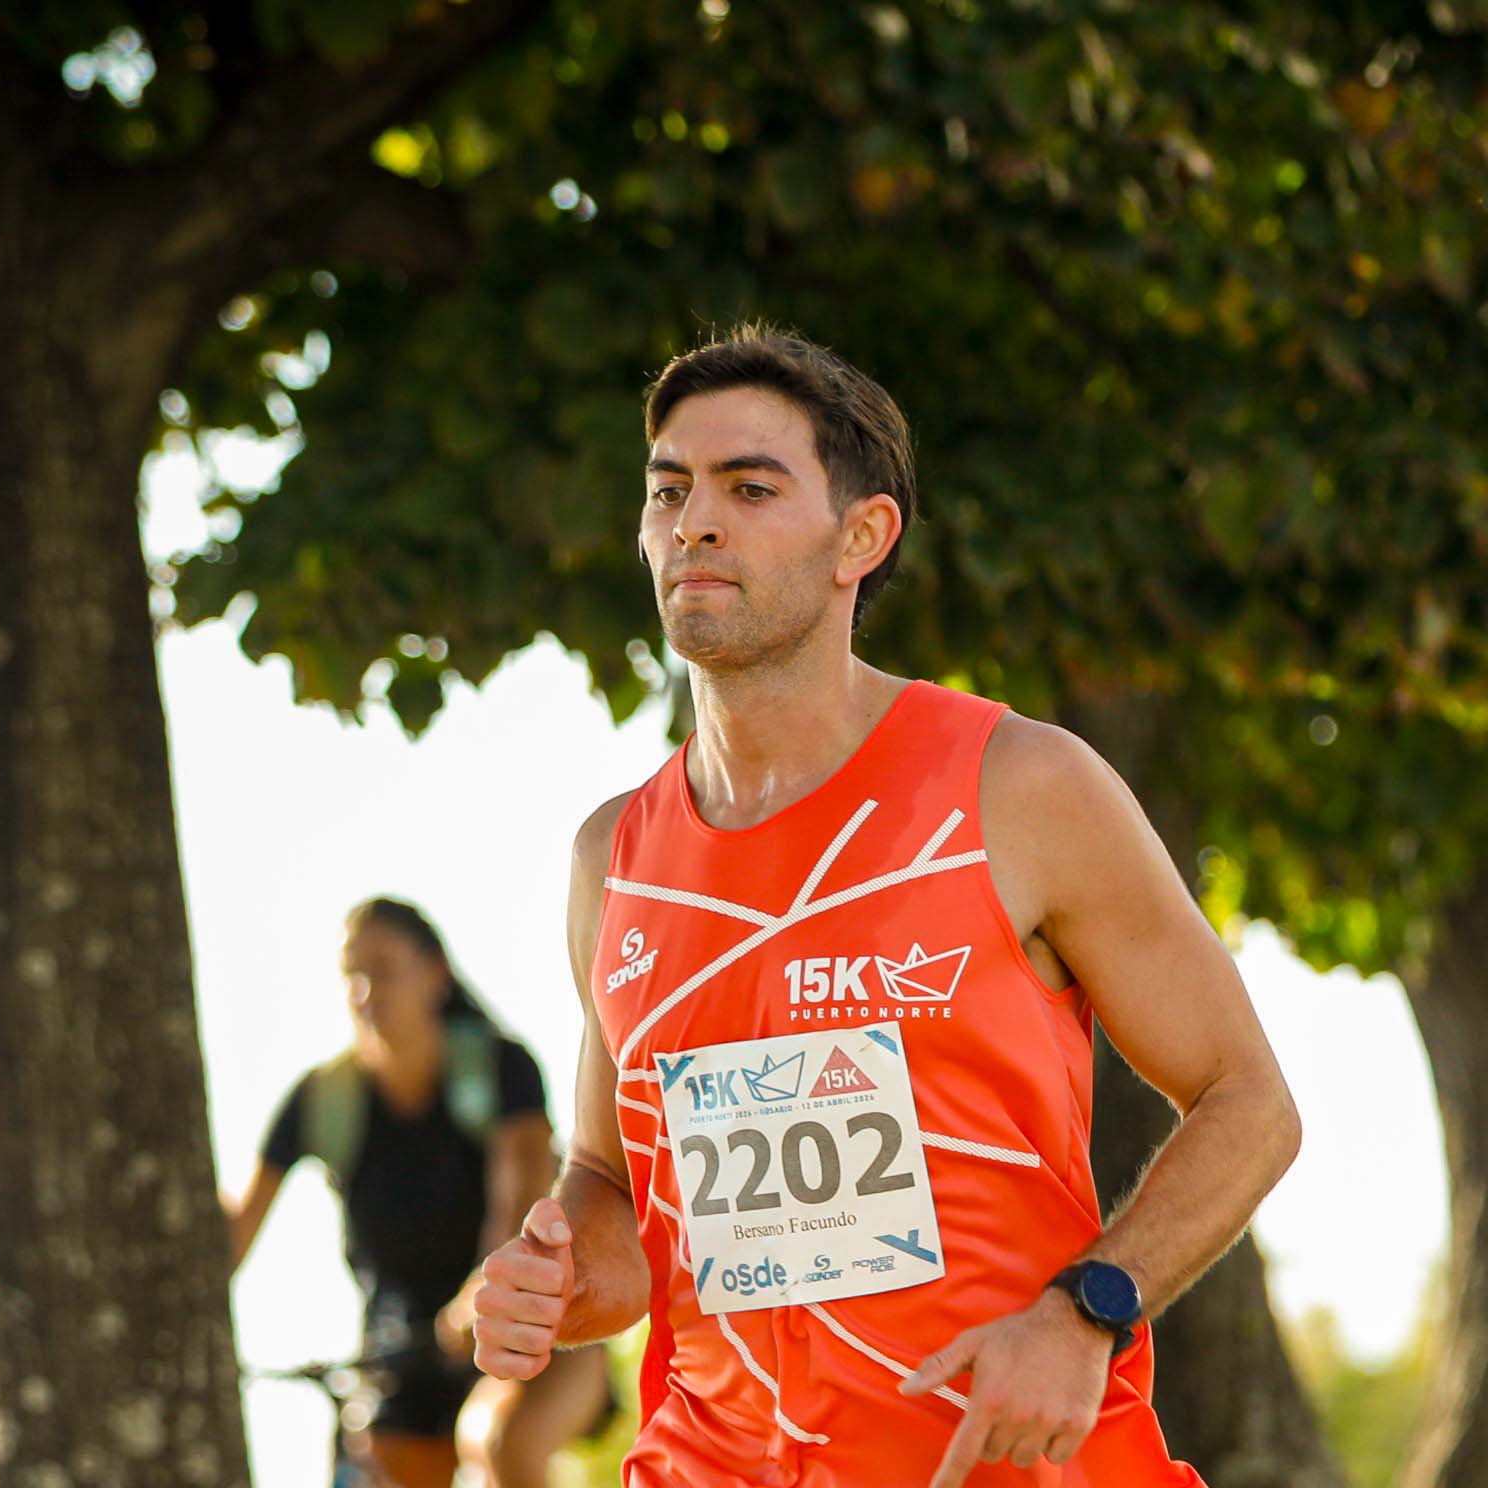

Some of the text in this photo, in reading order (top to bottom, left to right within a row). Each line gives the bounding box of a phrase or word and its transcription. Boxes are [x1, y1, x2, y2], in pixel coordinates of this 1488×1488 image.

[784, 956, 871, 1005] 15K
[790, 1006, 952, 1022] PUERTO NORTE
[684, 1069, 740, 1112] 15K
[821, 1066, 860, 1090] 15K
[680, 1112, 916, 1217] 2202
[733, 1211, 858, 1241] Bersano Facundo
[721, 1256, 788, 1293] osde
